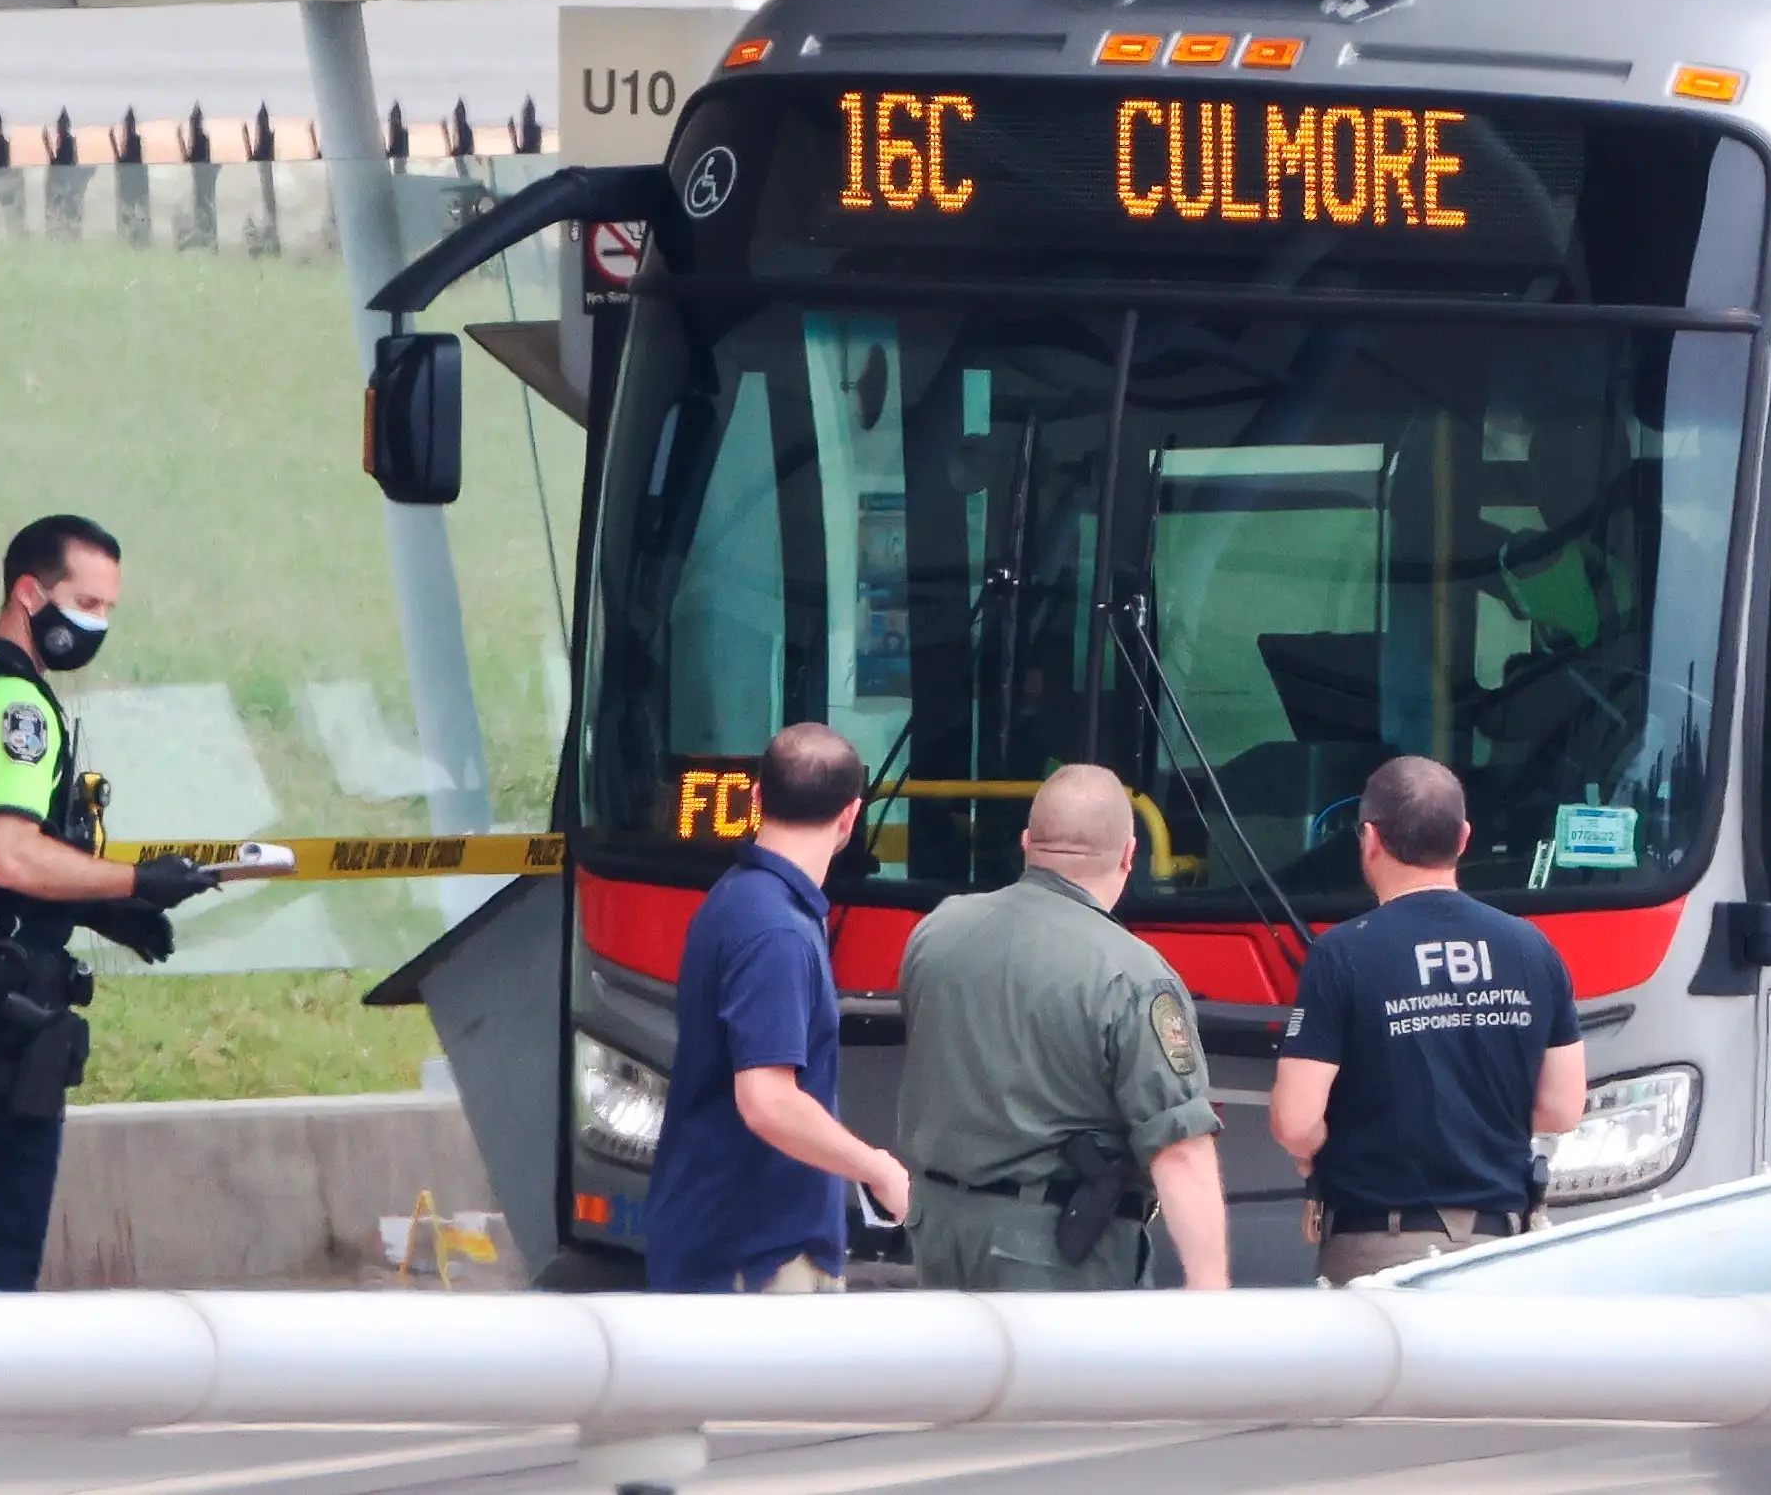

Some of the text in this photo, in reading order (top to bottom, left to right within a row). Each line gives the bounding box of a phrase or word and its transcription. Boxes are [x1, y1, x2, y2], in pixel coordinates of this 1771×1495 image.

[582, 67, 677, 117] U10
[839, 92, 1469, 229] 16C CULMORE
[678, 770, 762, 840] FC
[1414, 939, 1494, 986] FBI
[1384, 988, 1532, 1016] NATIONAL CAPITAL
[1388, 1010, 1533, 1037] RESPONSE SQUAD
